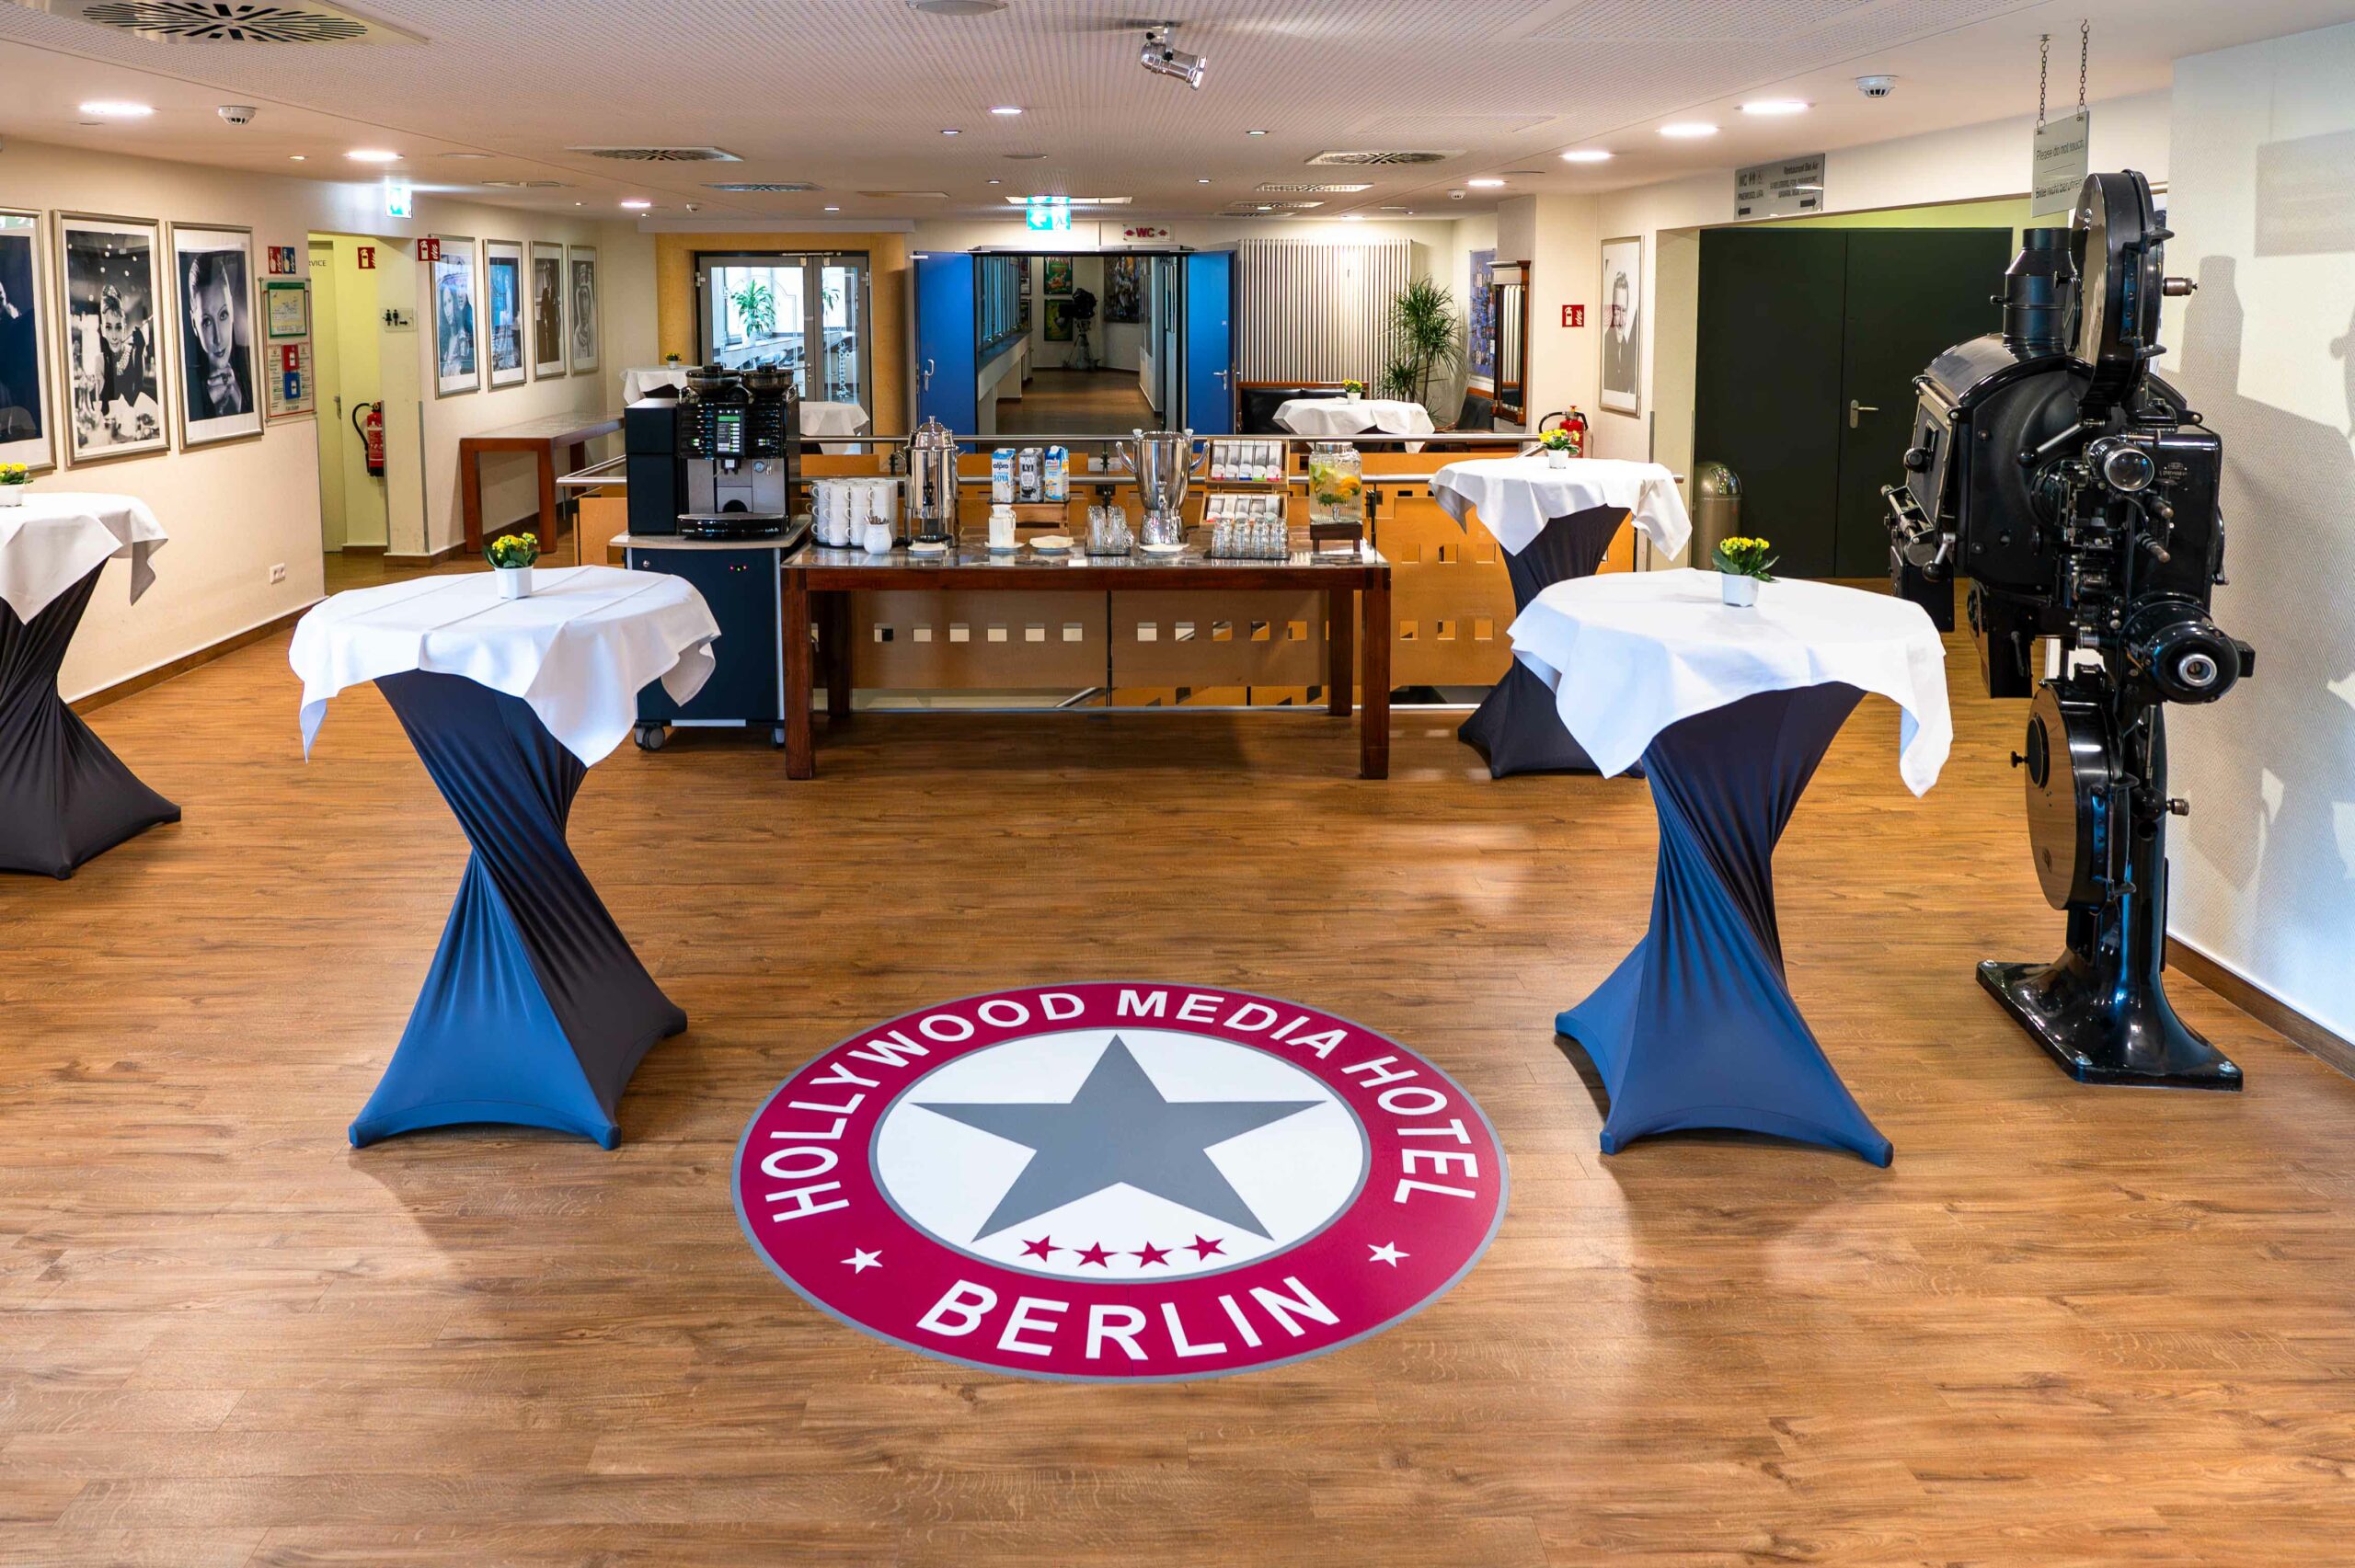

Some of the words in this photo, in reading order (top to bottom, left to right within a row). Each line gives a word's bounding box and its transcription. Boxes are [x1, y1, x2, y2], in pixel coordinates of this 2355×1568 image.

[2036, 148, 2052, 161] Please
[2052, 146, 2060, 157] do
[2061, 142, 2069, 155] not
[1136, 227, 1155, 237] WC
[993, 462, 1009, 470] alpro
[761, 992, 1085, 1222] HOLLYWOOD
[1117, 990, 1348, 1059] MEDIA
[1341, 1055, 1479, 1204] HOTEL
[916, 1276, 1340, 1361] BERLIN
